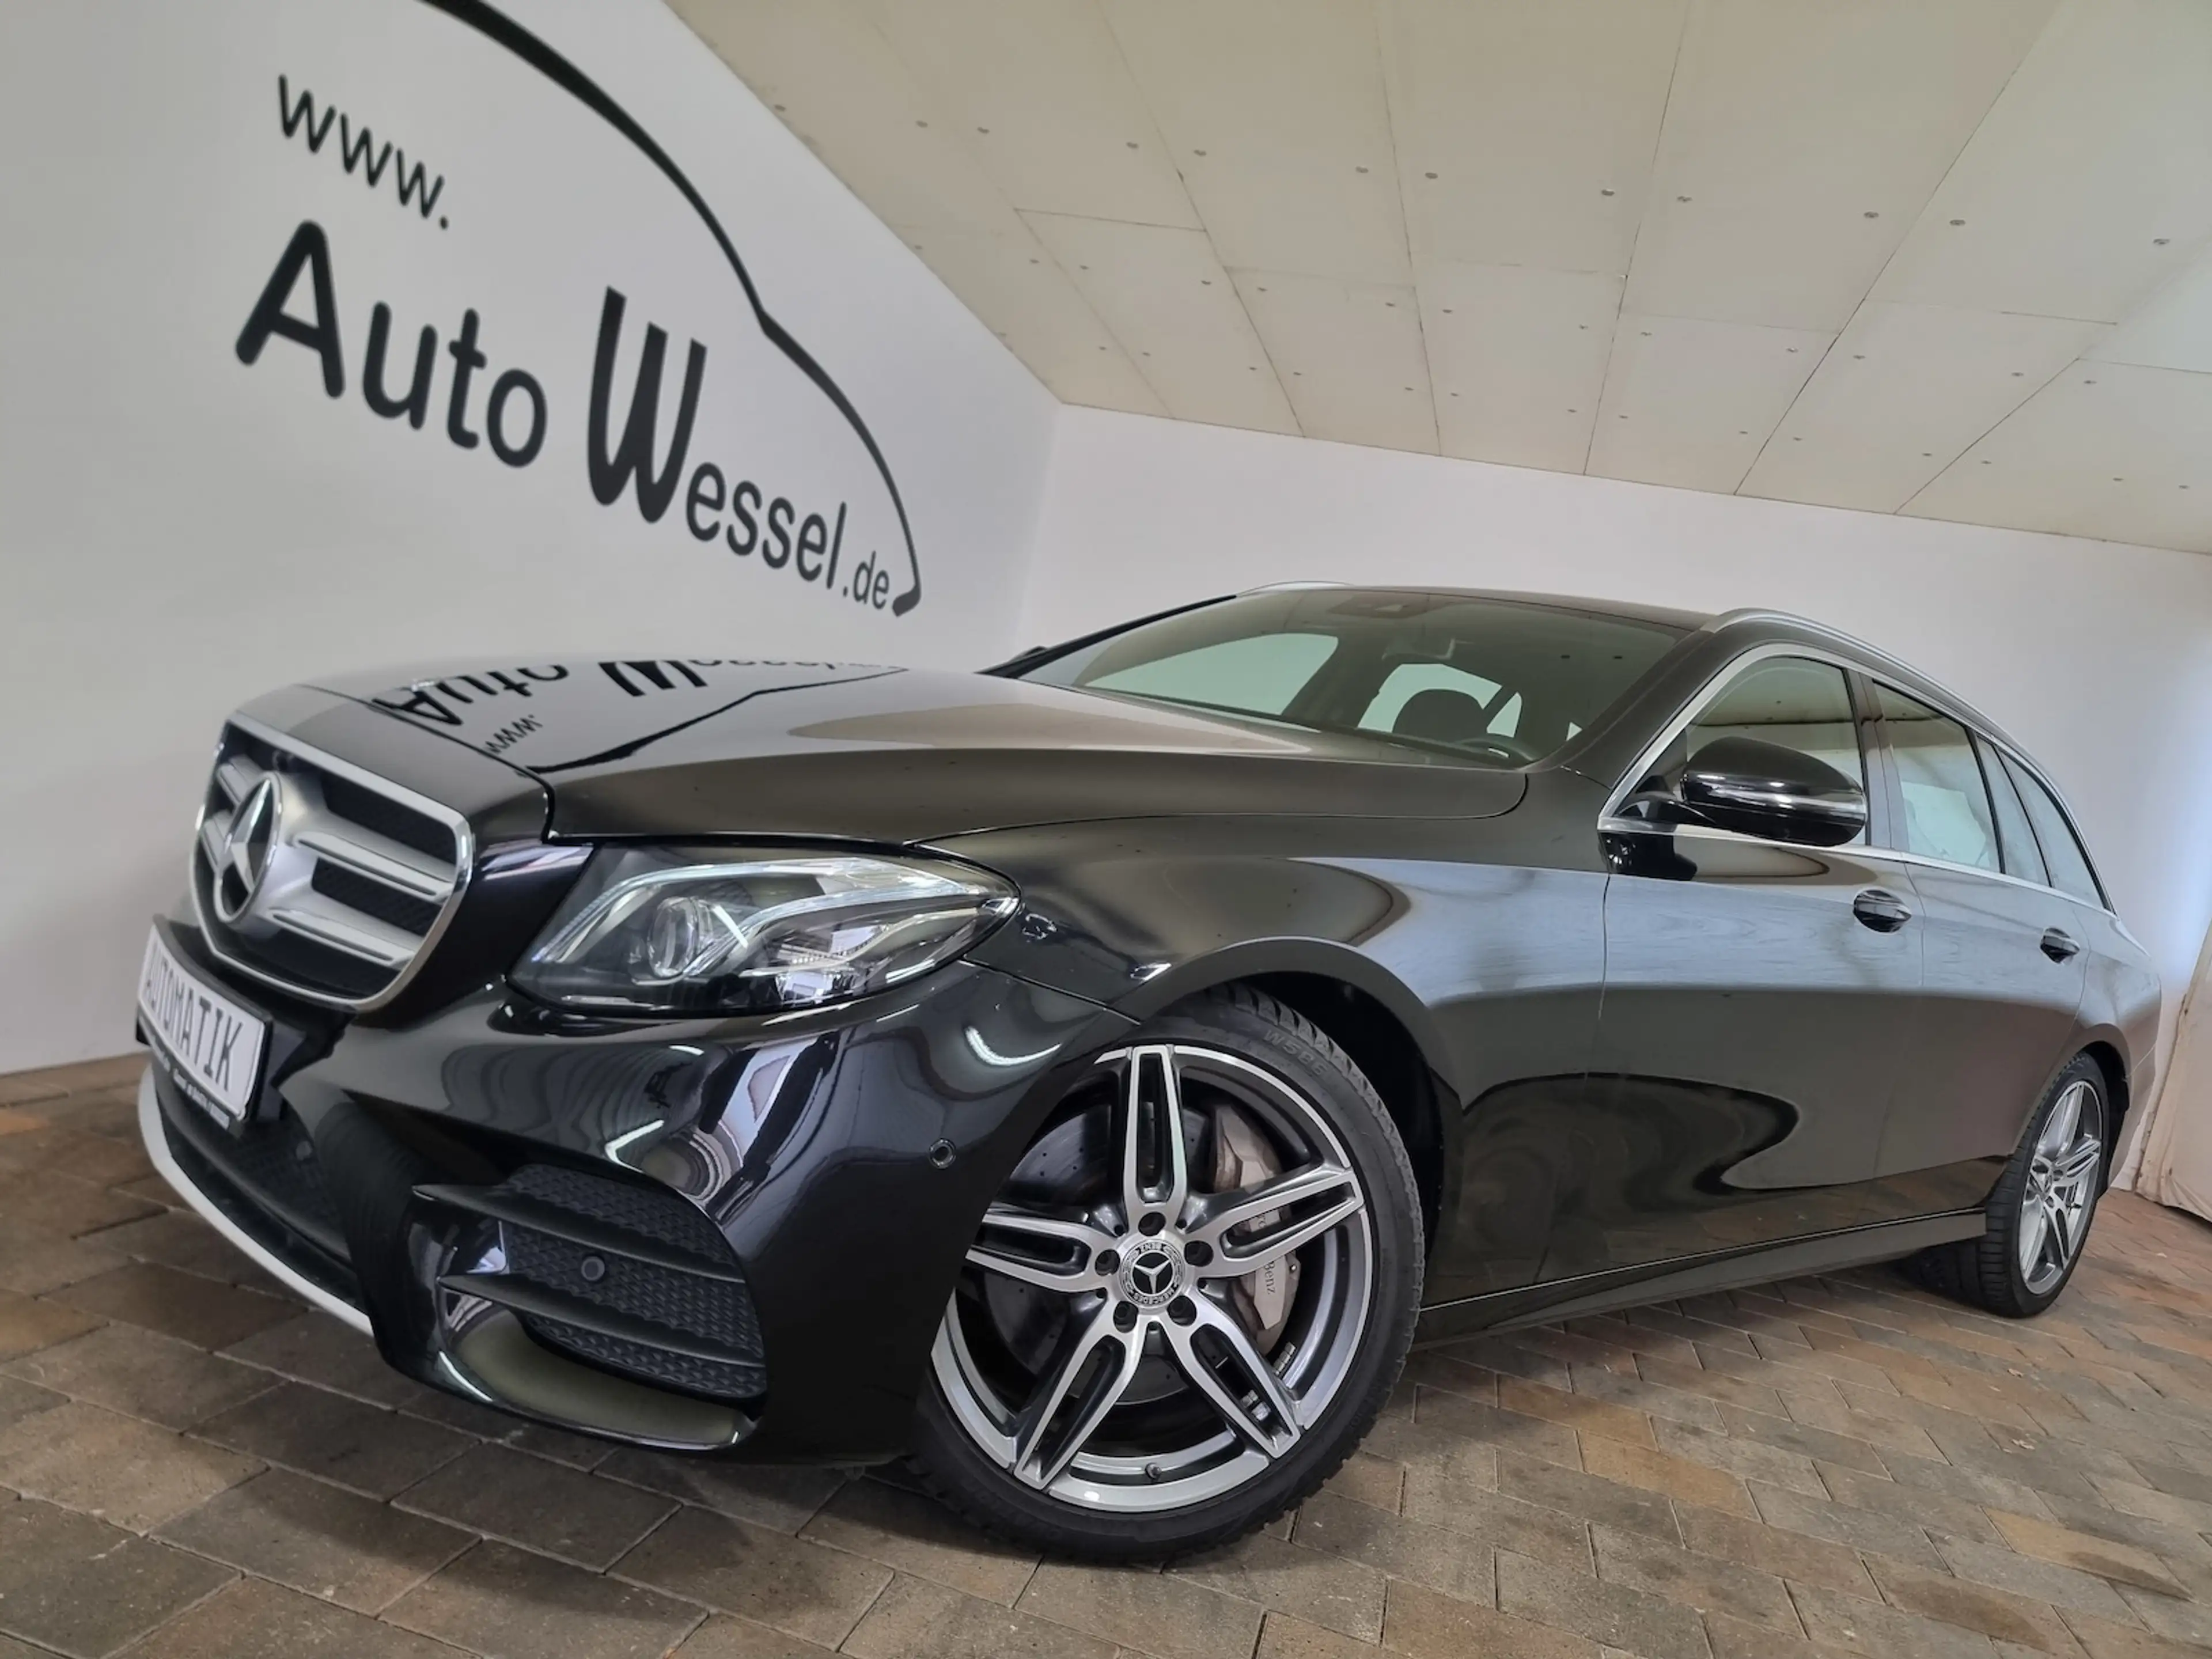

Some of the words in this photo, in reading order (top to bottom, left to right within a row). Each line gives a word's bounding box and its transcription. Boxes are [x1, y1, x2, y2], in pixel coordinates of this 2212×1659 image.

[278, 75, 448, 229] www.
[235, 221, 547, 468] Auto
[145, 940, 244, 1092] AUTOMATIK
